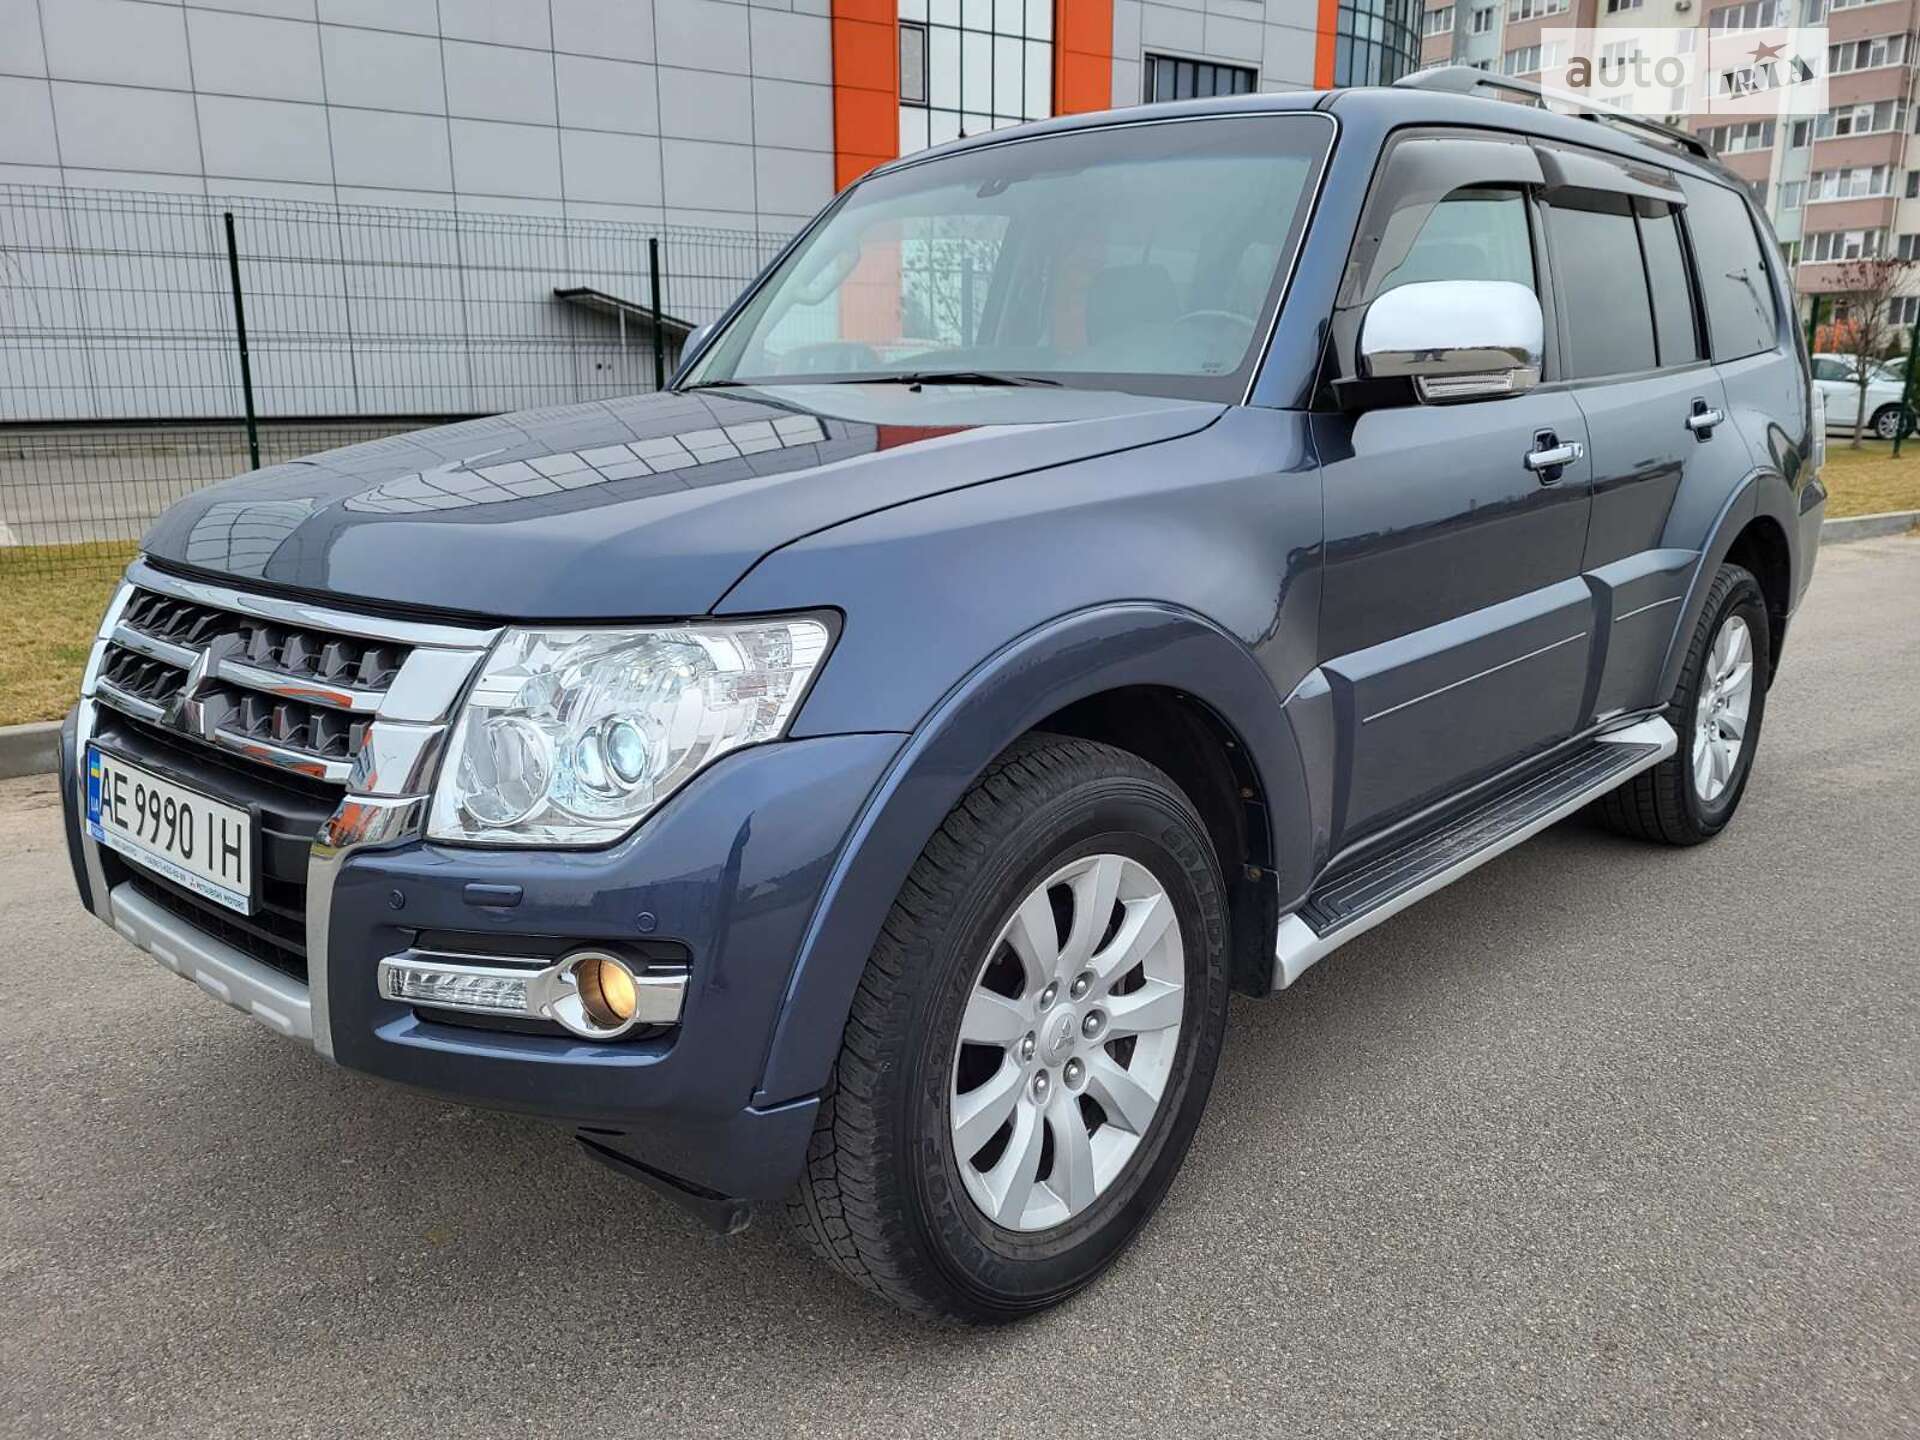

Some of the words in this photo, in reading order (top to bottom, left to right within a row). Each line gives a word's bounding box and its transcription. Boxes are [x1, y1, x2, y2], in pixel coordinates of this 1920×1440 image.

[100, 767, 128, 830] AE
[135, 783, 194, 860] 9990
[208, 811, 242, 884] IH
